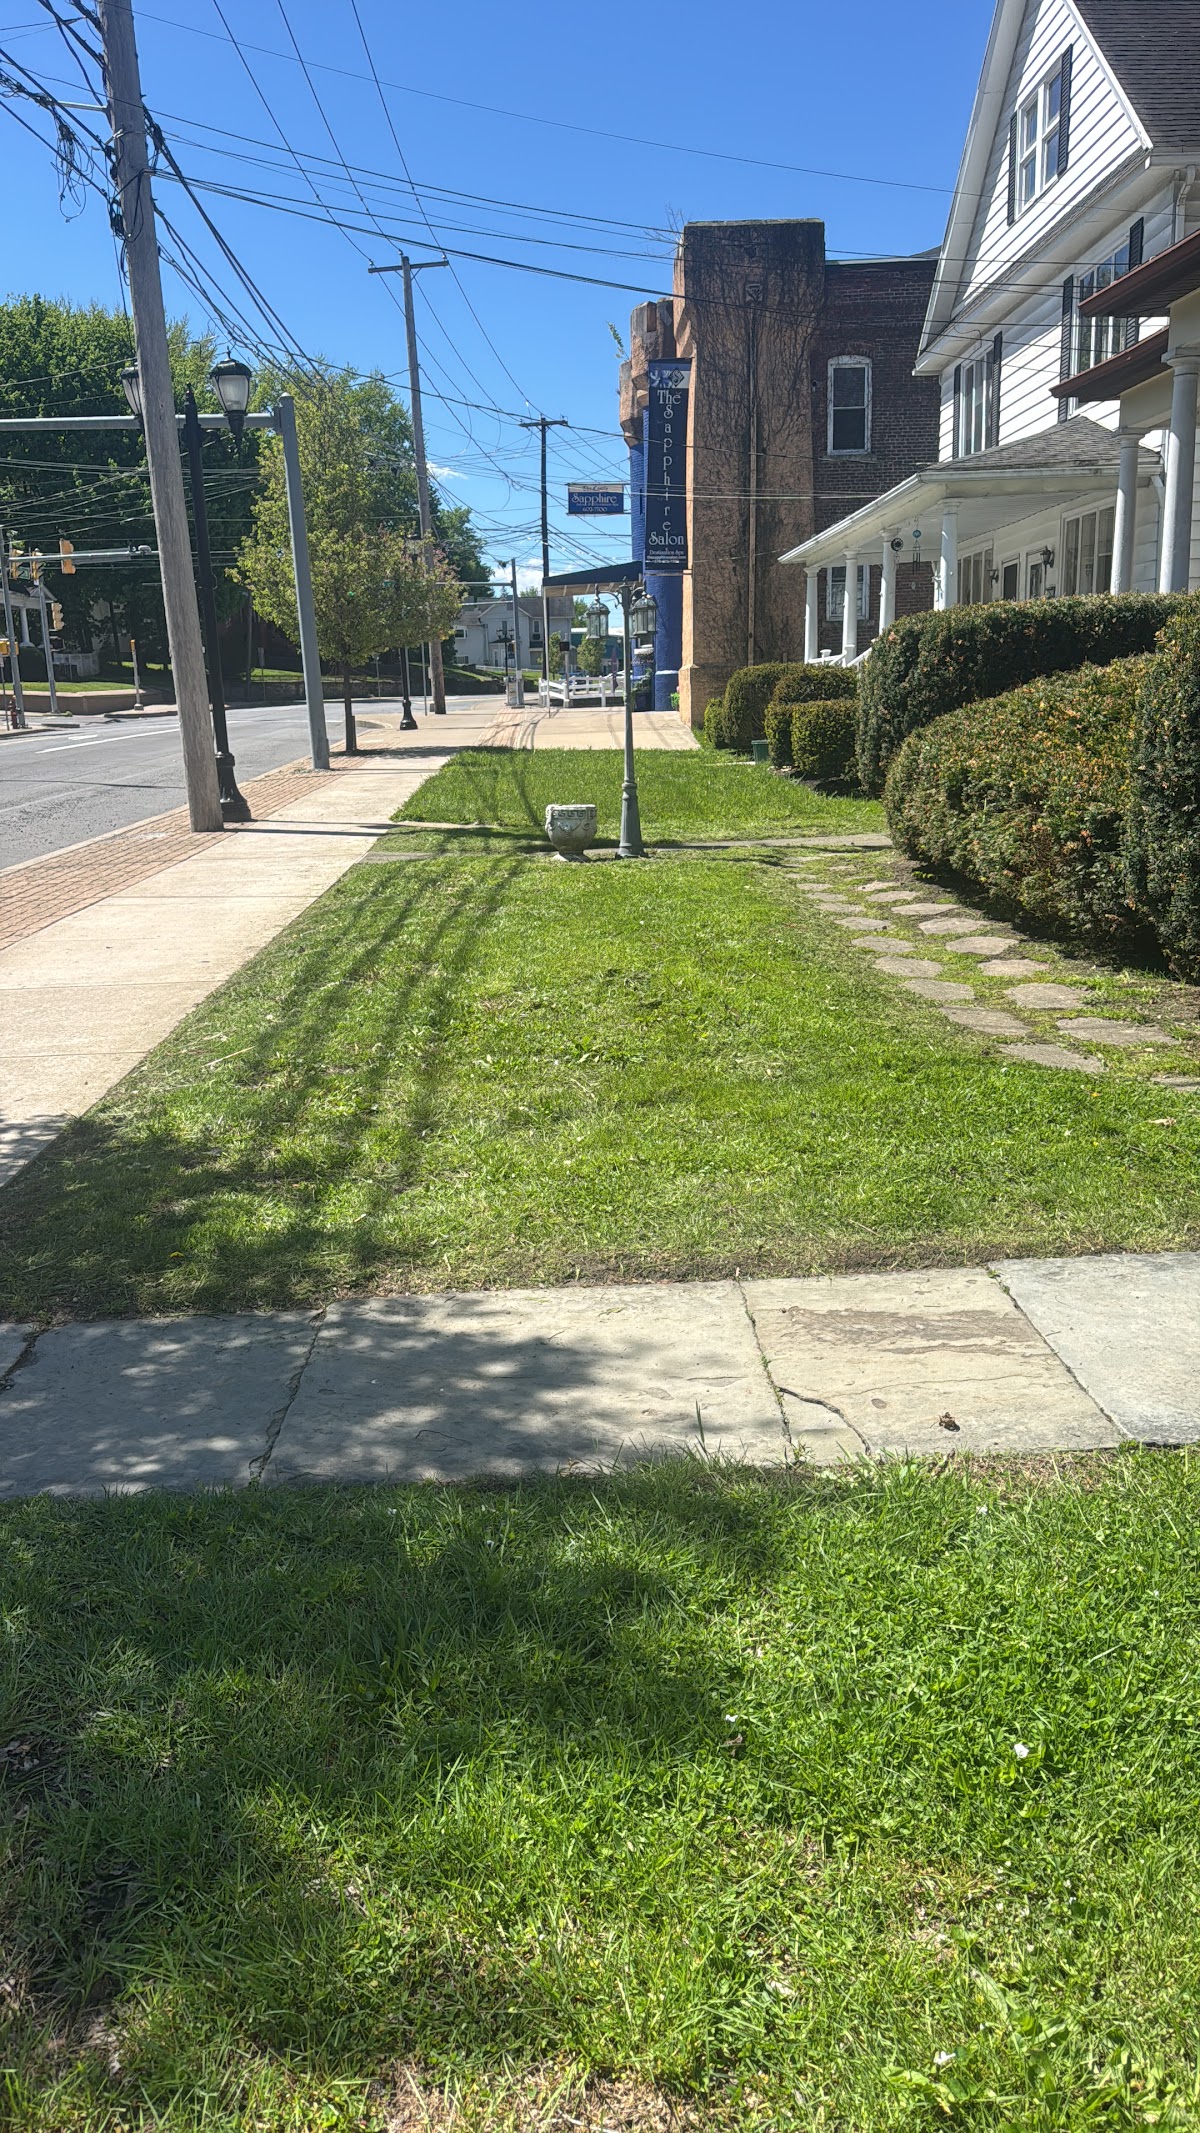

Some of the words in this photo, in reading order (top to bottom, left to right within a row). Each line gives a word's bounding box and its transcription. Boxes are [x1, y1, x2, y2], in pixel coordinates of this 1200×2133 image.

[657, 389, 682, 404] The
[662, 404, 673, 531] Sapphire
[571, 493, 618, 506] Sapphire
[648, 531, 685, 545] Salon
